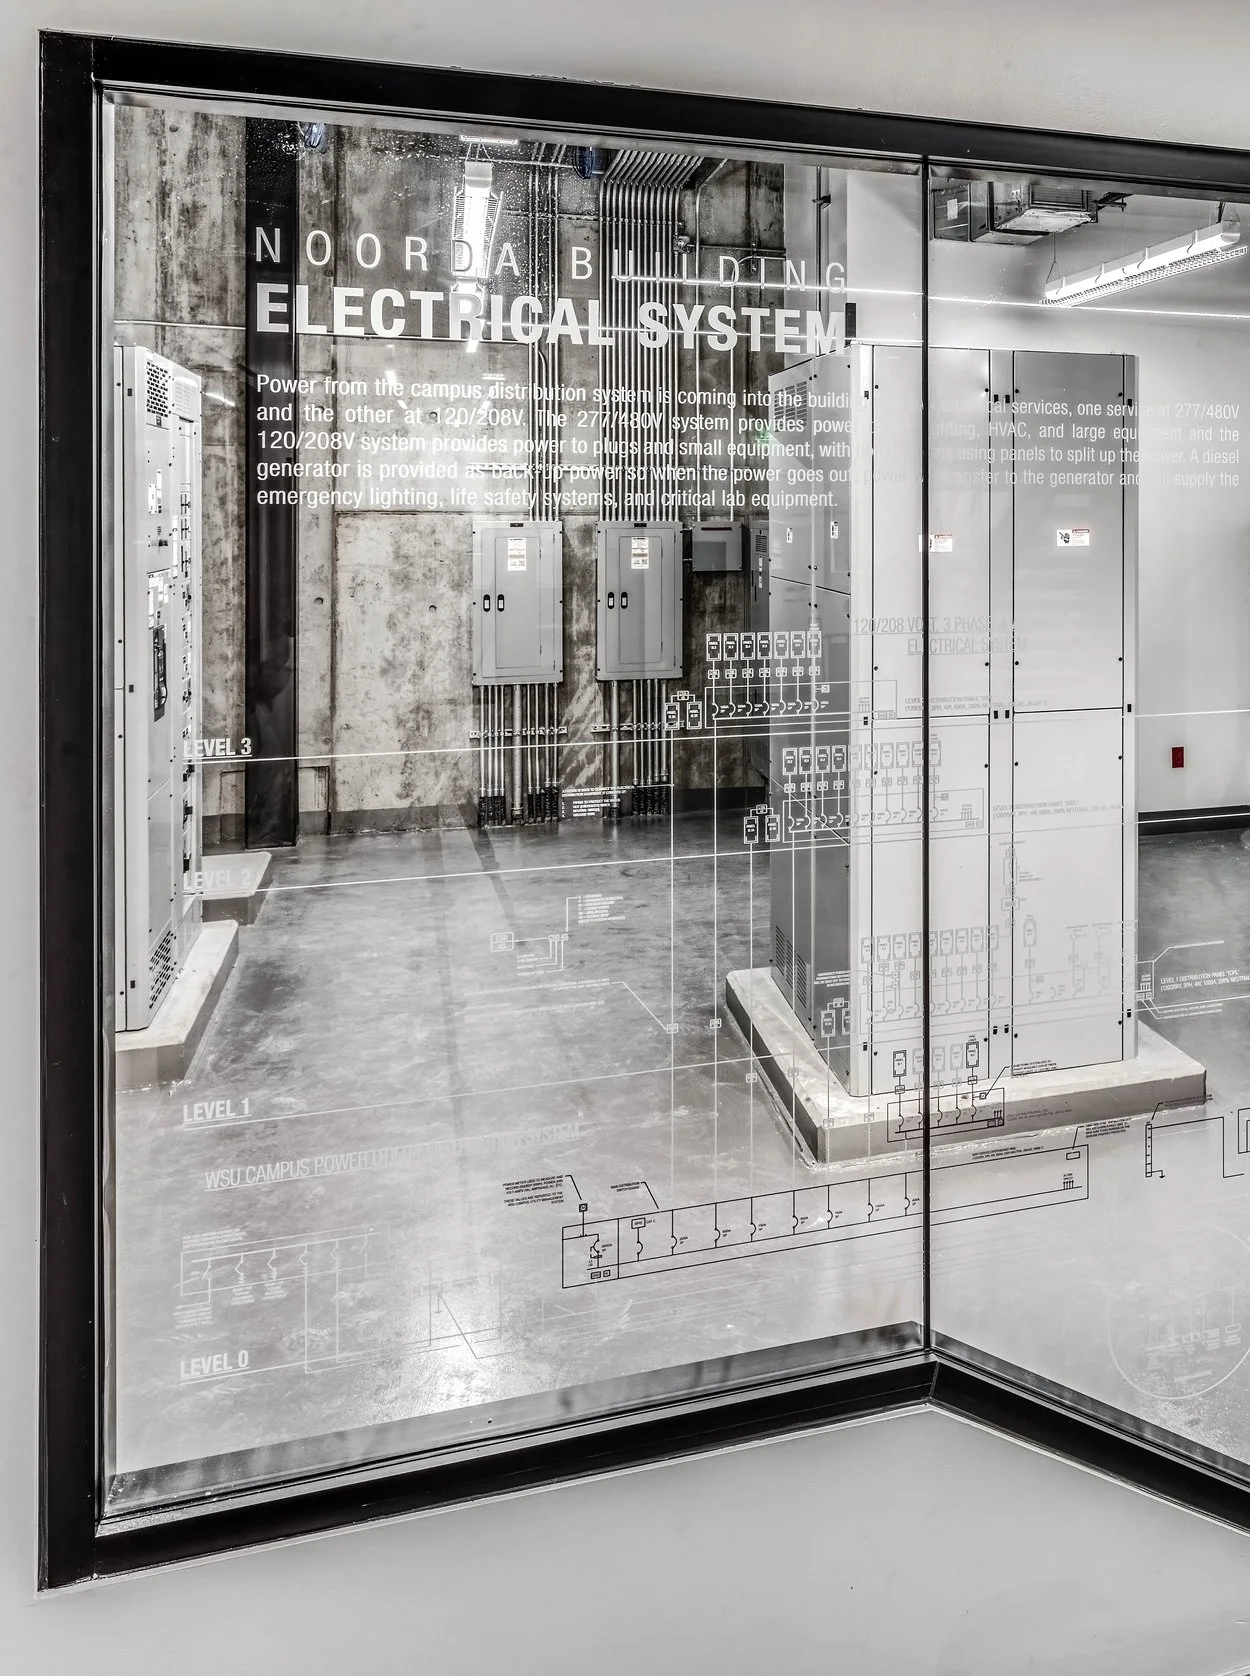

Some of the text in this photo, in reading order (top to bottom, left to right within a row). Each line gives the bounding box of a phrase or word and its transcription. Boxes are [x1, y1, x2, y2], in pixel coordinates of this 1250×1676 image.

[255, 227, 846, 293] NOORDA BUILDING
[256, 282, 846, 355] ELECTRICAL SYSTEM
[256, 374, 317, 394] Power
[324, 377, 367, 396] from
[374, 379, 404, 396] the
[411, 382, 482, 401] campus
[490, 382, 586, 401] distribution
[592, 386, 651, 406] system
[658, 387, 671, 404] is
[678, 388, 736, 409] coming
[743, 389, 772, 407] into
[777, 391, 802, 407] the
[808, 391, 867, 410] buildig
[256, 403, 293, 422] and
[304, 404, 334, 422] the
[345, 405, 394, 423] other
[405, 407, 422, 424] at
[436, 408, 527, 427] 120/208V.
[536, 410, 567, 428] The
[577, 410, 663, 430] 277/480V
[672, 415, 729, 434] system
[738, 415, 804, 434] provides
[813, 419, 855, 436] powe
[1012, 399, 1073, 418] services,
[1077, 403, 1102, 416] one
[1158, 404, 1171, 418] at
[1175, 403, 1240, 420] 277/480V
[931, 420, 981, 440] ghting,
[987, 421, 1032, 440] HVAC,
[1039, 423, 1064, 438] and
[1072, 423, 1106, 442] large
[1113, 425, 1182, 442] equment
[1189, 427, 1213, 441] and
[1219, 427, 1240, 442] the
[257, 431, 356, 449] 120/208V
[361, 434, 426, 455] system
[432, 435, 507, 455] provides
[513, 438, 564, 456] power
[572, 438, 588, 454] to
[593, 437, 639, 458] plugs
[643, 439, 674, 456] and
[679, 439, 722, 456] small
[727, 441, 815, 460] equipment,
[819, 441, 851, 458] with
[958, 447, 996, 463] using
[1000, 446, 1046, 462] panels
[1050, 448, 1063, 462] to
[1067, 447, 1096, 464] split
[1099, 451, 1116, 465] up
[1119, 449, 1139, 463] the
[1141, 450, 1187, 465] ower.
[1189, 449, 1199, 464] A
[1202, 449, 1240, 464] diesel
[257, 462, 351, 481] generator
[358, 460, 372, 478] is
[379, 461, 458, 482] provided
[465, 465, 485, 479] as
[491, 464, 564, 484] back-up
[569, 467, 621, 484] power
[627, 467, 645, 481] so
[652, 464, 695, 482] when
[703, 464, 727, 481] the
[734, 467, 782, 485] power
[787, 467, 824, 485] goes
[1005, 470, 1018, 485] to
[1023, 469, 1045, 485] the
[1050, 471, 1114, 488] generator
[1174, 471, 1216, 490] supply
[1219, 472, 1240, 486] the
[257, 488, 838, 510] emergency lighting, life safety systems, and critical lab equipment.
[854, 617, 904, 633] 120/208
[907, 616, 940, 634] VOT,
[943, 617, 950, 632] 3
[906, 637, 977, 654] ELCTRICAL
[183, 737, 252, 757] LEVEL 3
[183, 872, 236, 892] LEVEL
[183, 1097, 250, 1122] LEVEL 1
[205, 1168, 241, 1190] WSU
[245, 1158, 311, 1184] CAMPUS
[314, 1151, 369, 1174] POWER
[180, 1350, 249, 1378] LEVEL 0
